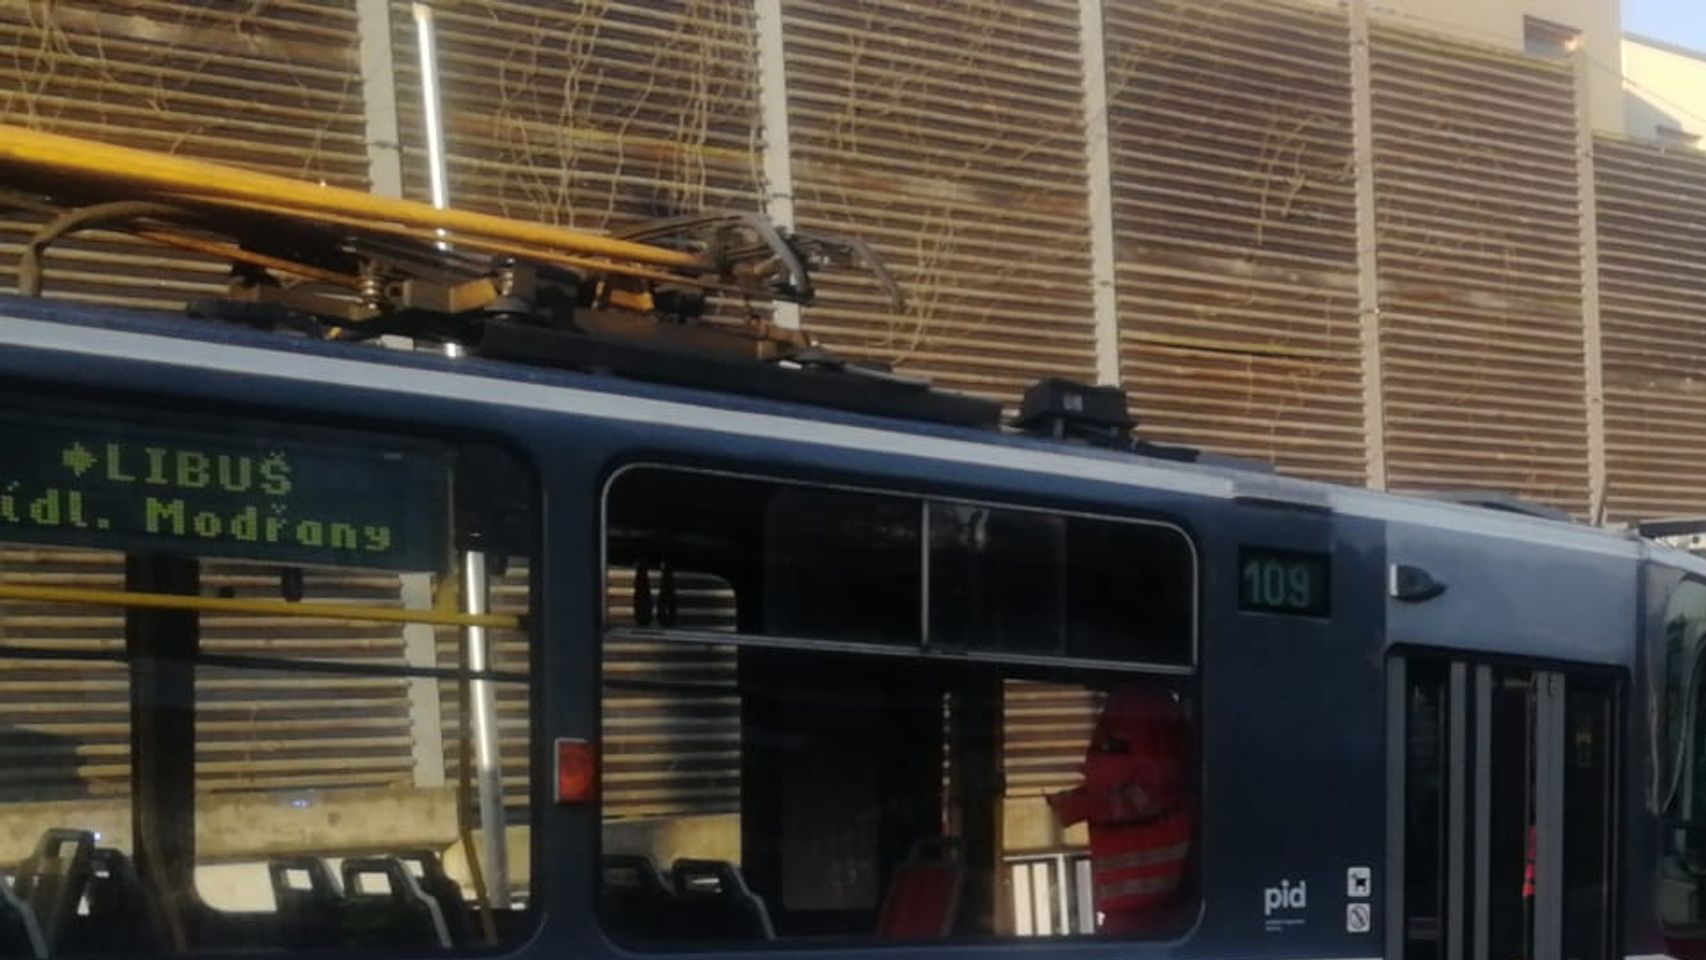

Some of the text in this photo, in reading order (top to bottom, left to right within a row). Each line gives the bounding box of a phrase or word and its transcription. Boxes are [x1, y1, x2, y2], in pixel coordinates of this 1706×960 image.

[106, 443, 292, 495] LIBUŠ
[145, 497, 391, 551] Modřany
[1244, 560, 1310, 607] 109
[1265, 879, 1306, 915] pid
